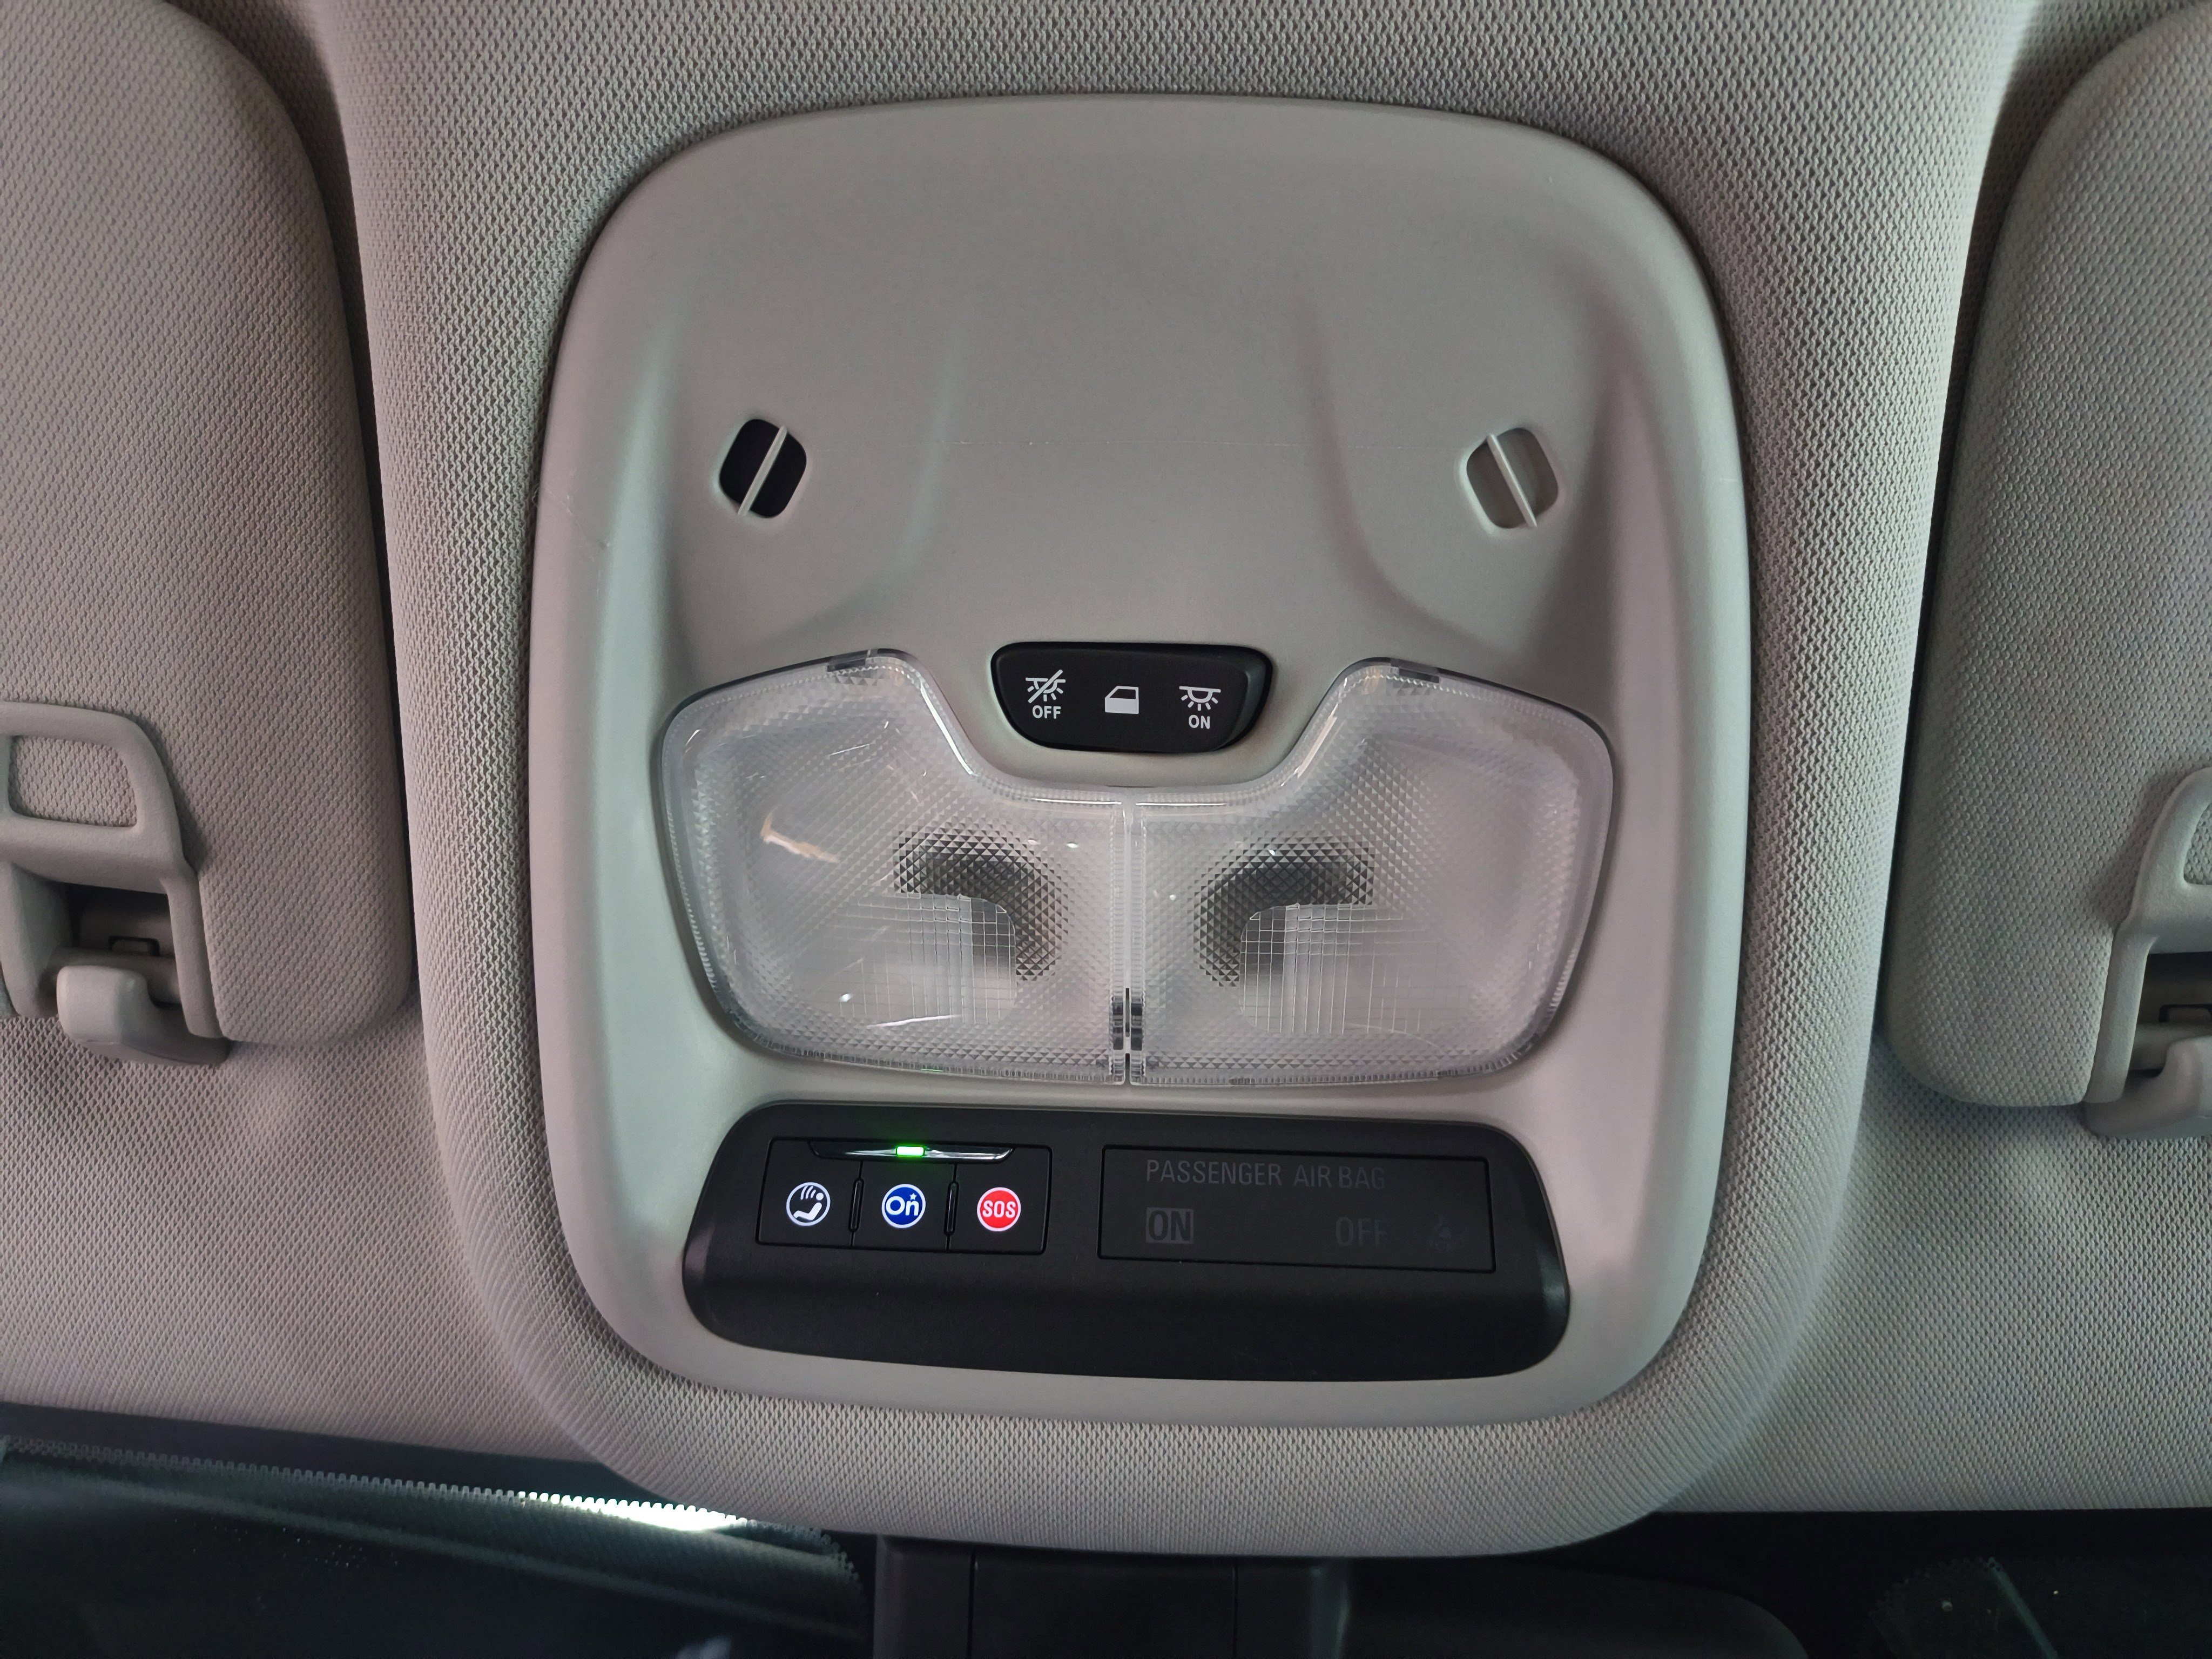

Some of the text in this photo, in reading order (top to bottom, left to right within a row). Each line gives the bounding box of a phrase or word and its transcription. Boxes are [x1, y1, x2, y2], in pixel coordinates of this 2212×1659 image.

[1033, 705, 1061, 719] OFF
[1188, 714, 1211, 729] ON
[1145, 1159, 1283, 1186] PASSENGER
[885, 1196, 920, 1217] On
[981, 1202, 1016, 1219] SOS
[1148, 1209, 1192, 1242] ON
[1336, 1216, 1386, 1245] OFF
